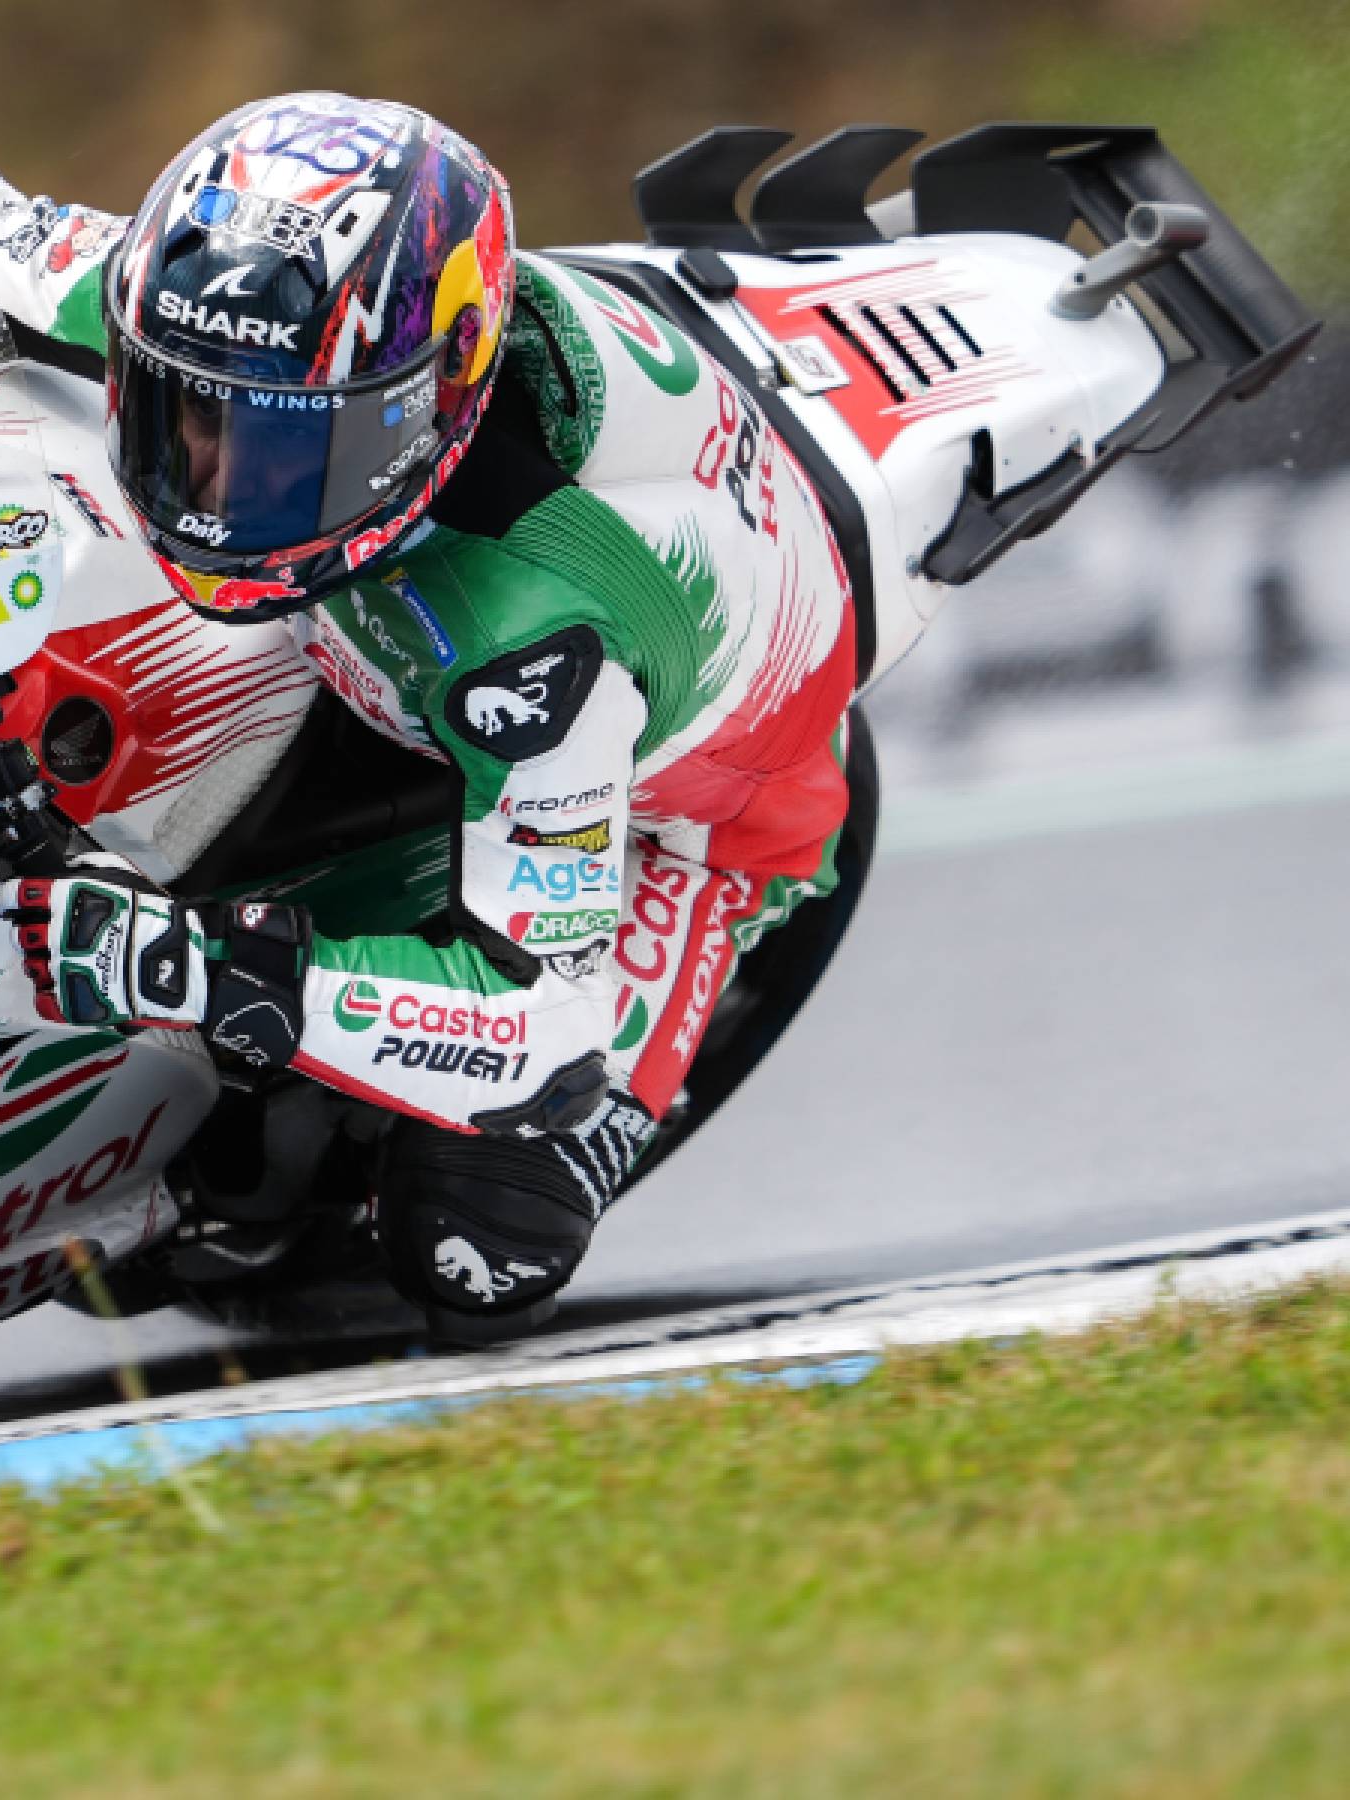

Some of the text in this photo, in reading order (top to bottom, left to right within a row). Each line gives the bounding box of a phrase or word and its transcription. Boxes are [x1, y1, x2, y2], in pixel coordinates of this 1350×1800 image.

[156, 290, 301, 351] SHARK
[180, 371, 232, 400] YOU
[249, 388, 347, 410] WINGS
[387, 993, 528, 1046] Castrol
[373, 1035, 529, 1083] POWER1
